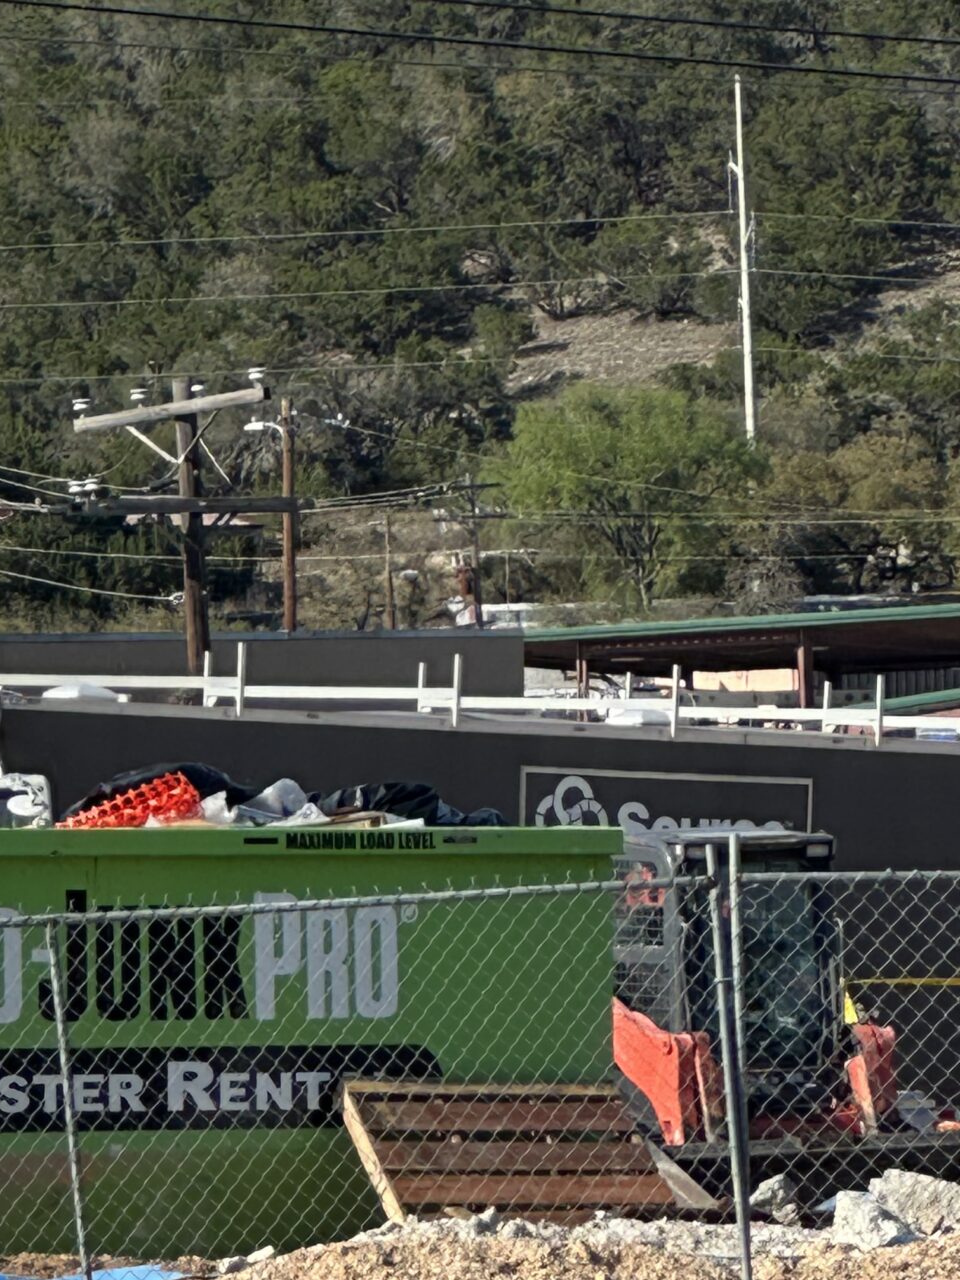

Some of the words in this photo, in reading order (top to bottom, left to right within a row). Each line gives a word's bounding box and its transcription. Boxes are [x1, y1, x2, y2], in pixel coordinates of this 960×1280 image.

[285, 832, 357, 849] MAXIMUM
[359, 832, 395, 849] LOAD
[398, 832, 436, 849] LEVEL
